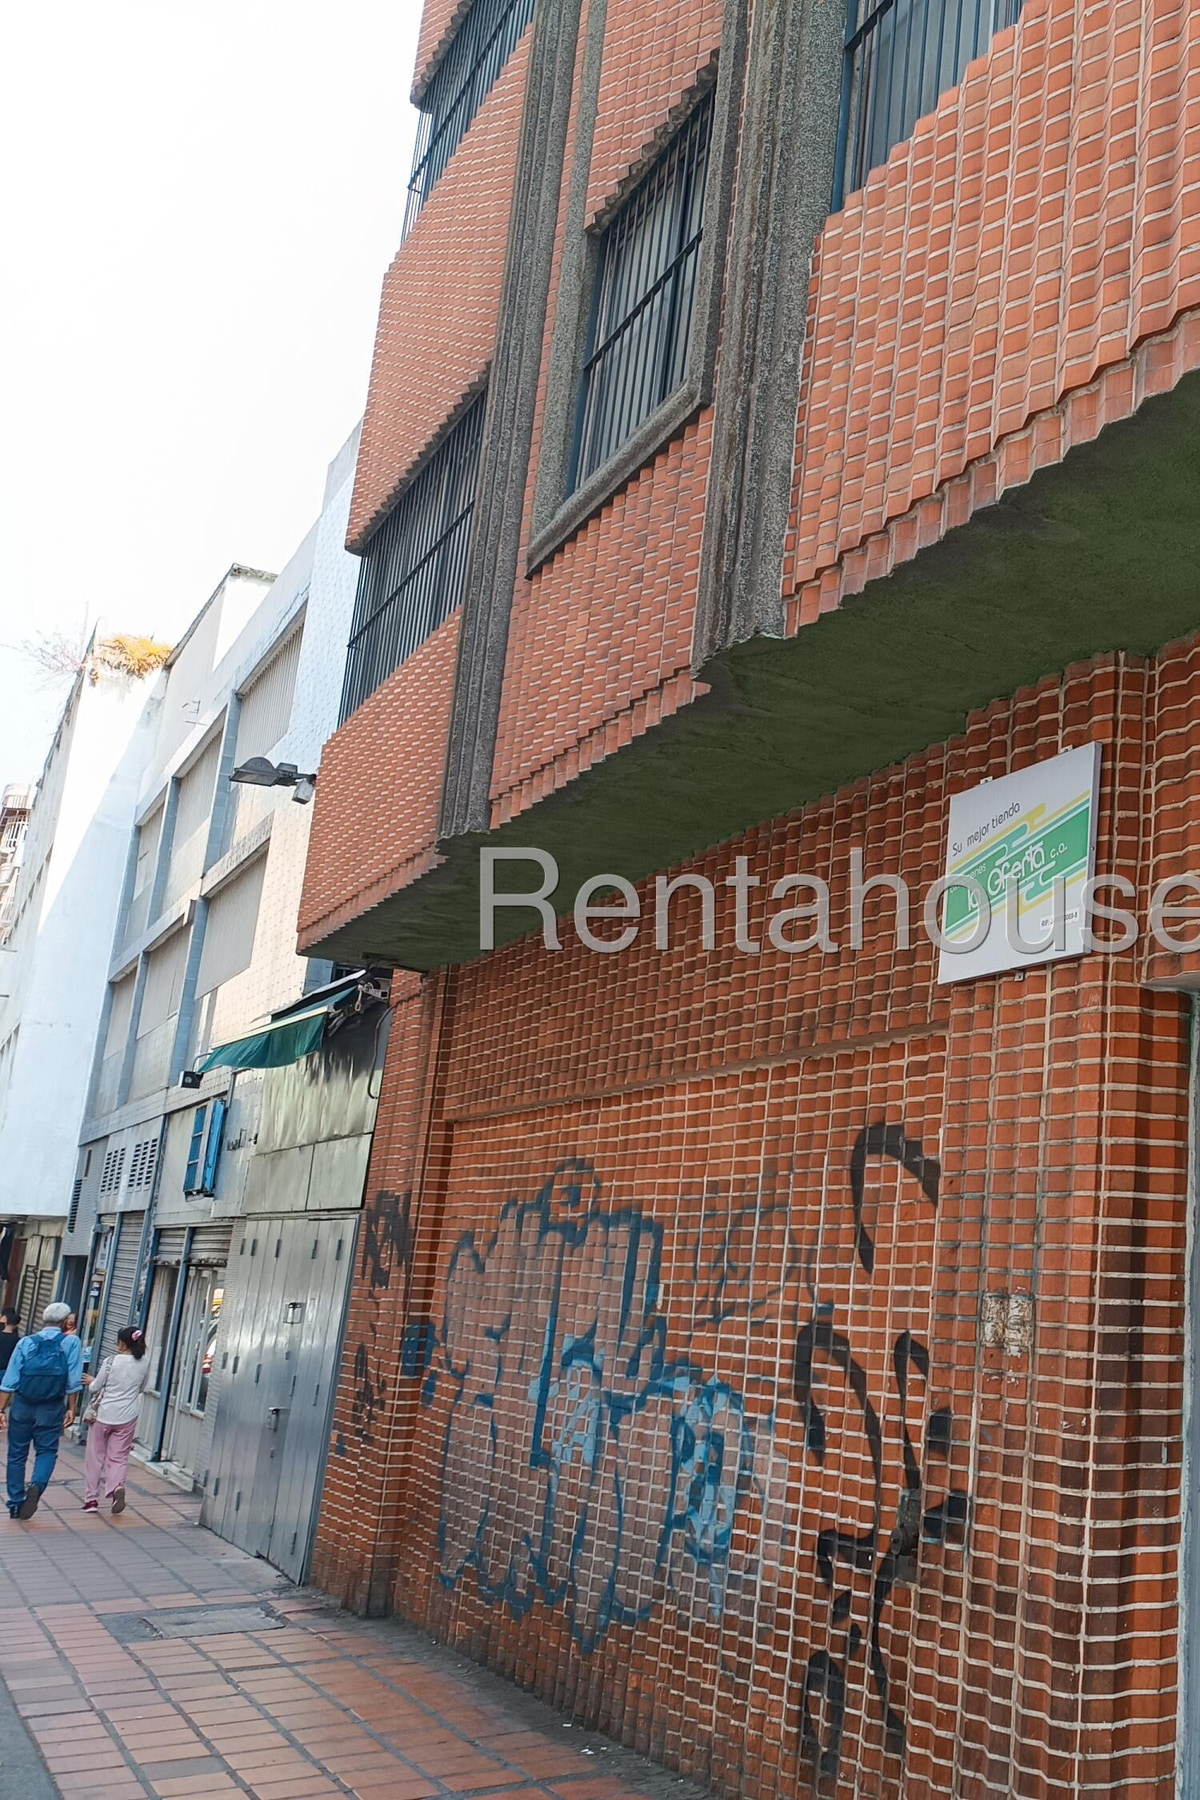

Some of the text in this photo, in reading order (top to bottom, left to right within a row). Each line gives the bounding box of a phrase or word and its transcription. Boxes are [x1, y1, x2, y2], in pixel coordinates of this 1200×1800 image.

[952, 802, 1020, 857] Su mejor tienda
